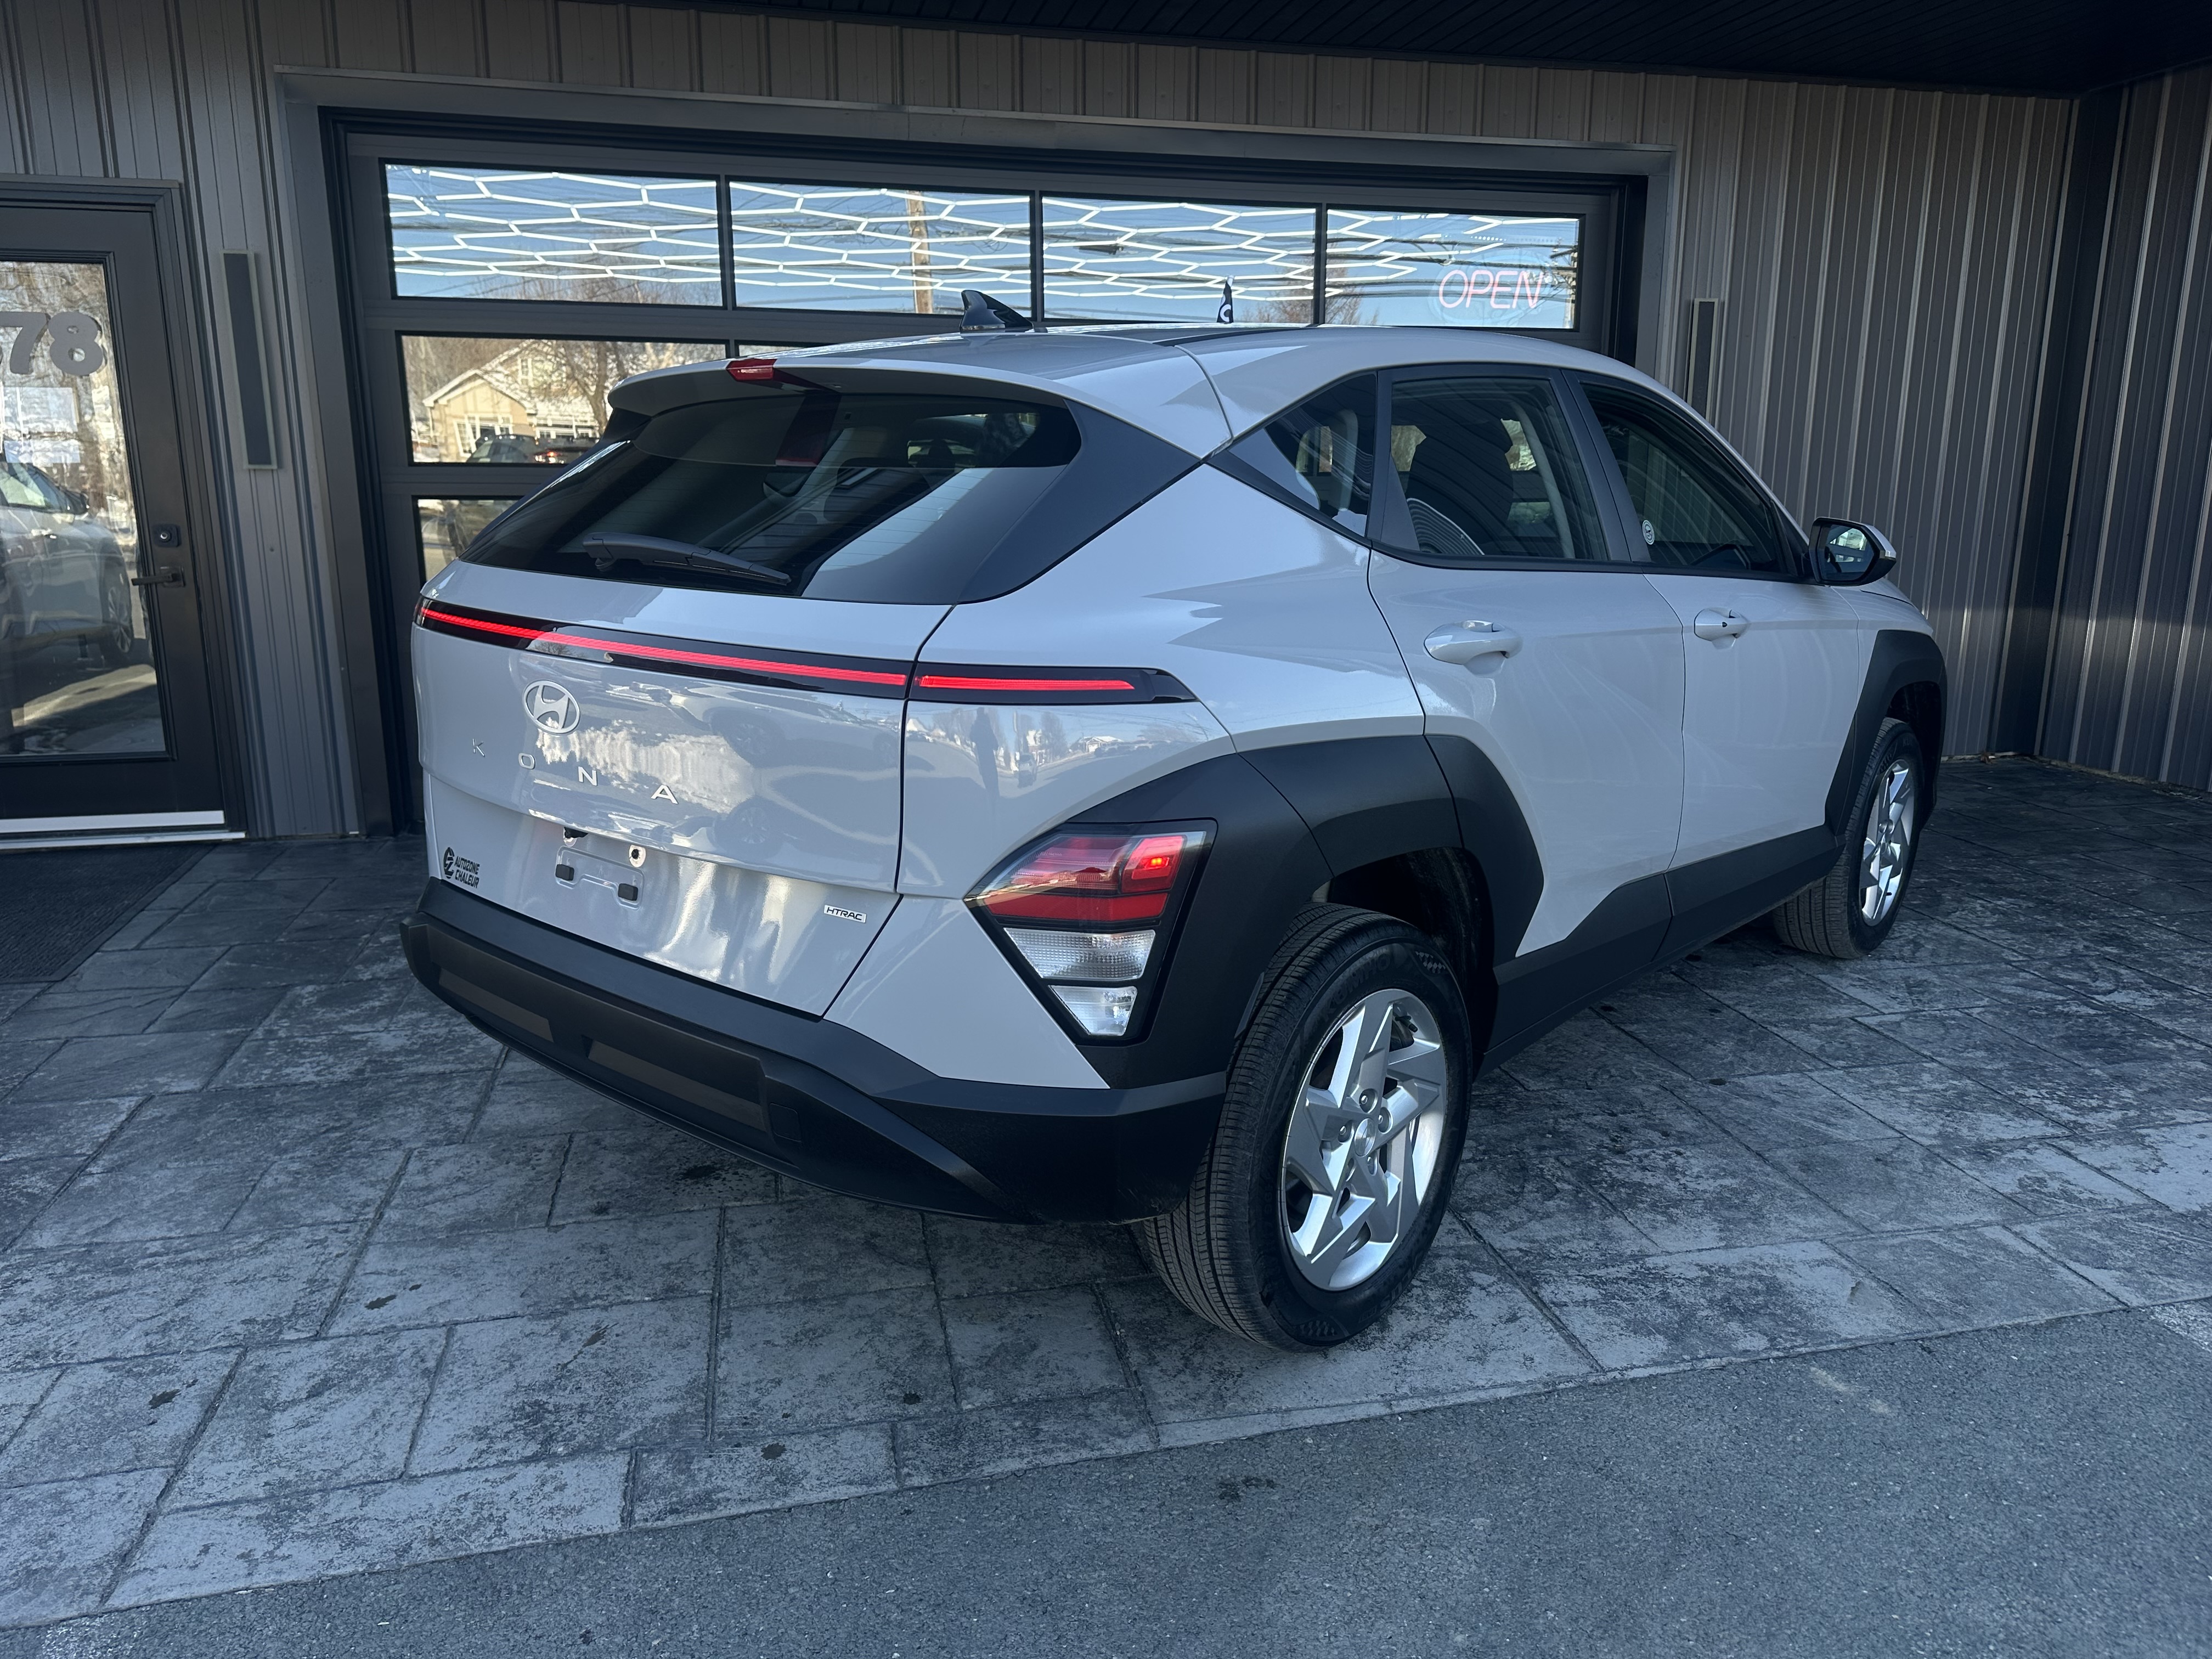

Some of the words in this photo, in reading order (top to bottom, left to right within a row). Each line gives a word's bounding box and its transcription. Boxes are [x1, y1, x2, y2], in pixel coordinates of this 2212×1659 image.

[1438, 269, 1544, 309] OPEN
[472, 738, 679, 804] KONA
[454, 855, 480, 875] AUTOZONE
[455, 869, 480, 888] CHALEUR
[826, 906, 862, 921] HTRAC
